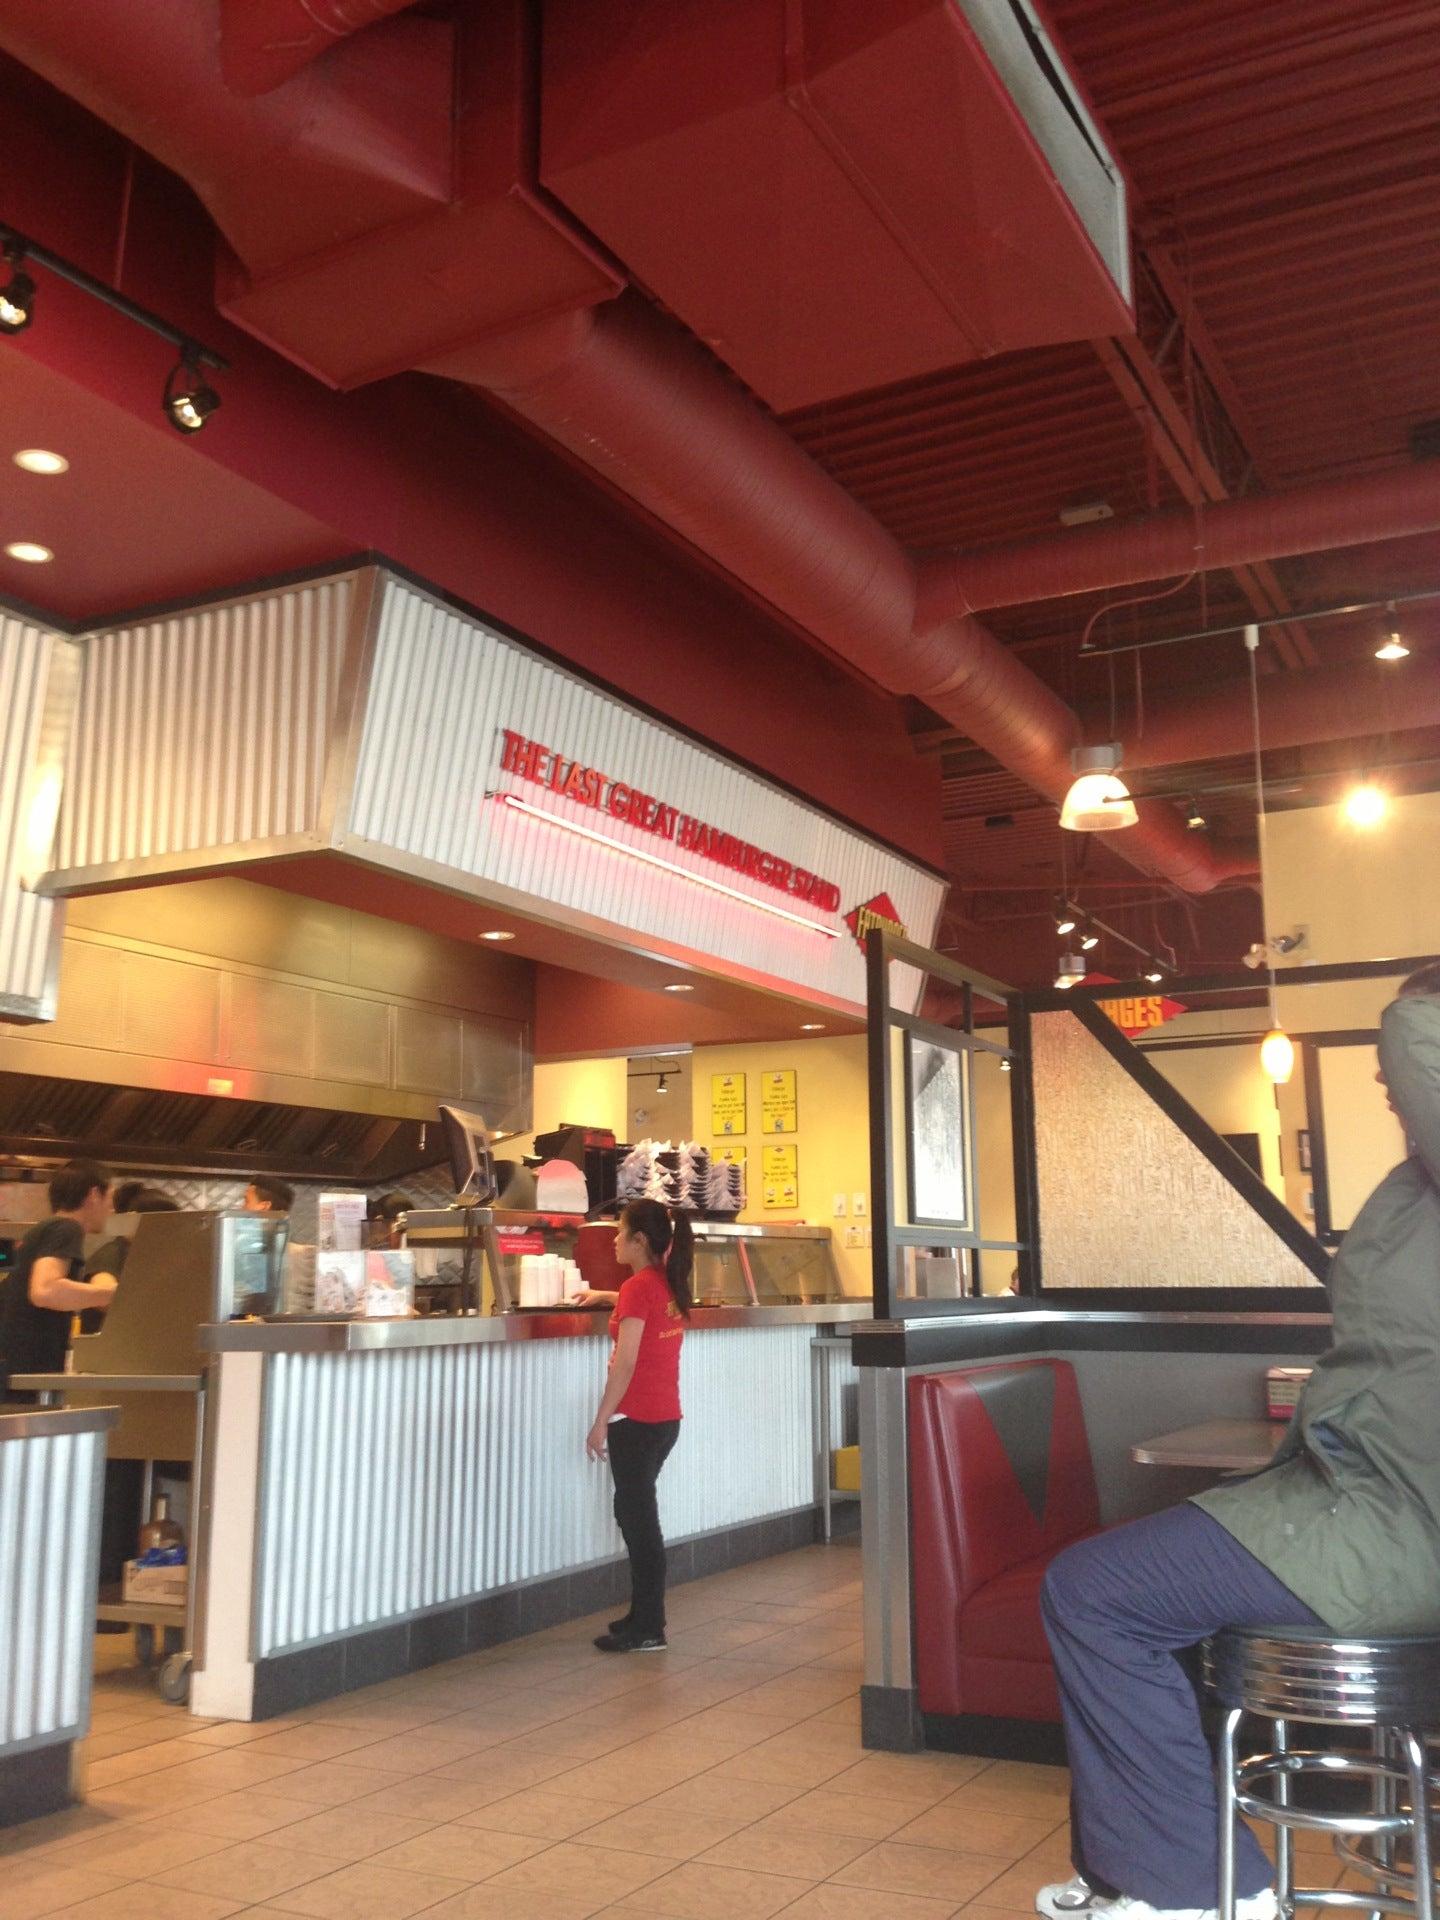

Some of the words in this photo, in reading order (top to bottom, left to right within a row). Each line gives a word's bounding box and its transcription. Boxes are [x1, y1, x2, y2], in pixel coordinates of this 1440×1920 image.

[501, 729, 550, 786] THE
[551, 753, 609, 808] LAST
[609, 782, 680, 840] GREAT
[677, 813, 793, 892] HAMBURGER
[788, 867, 840, 913] STAND
